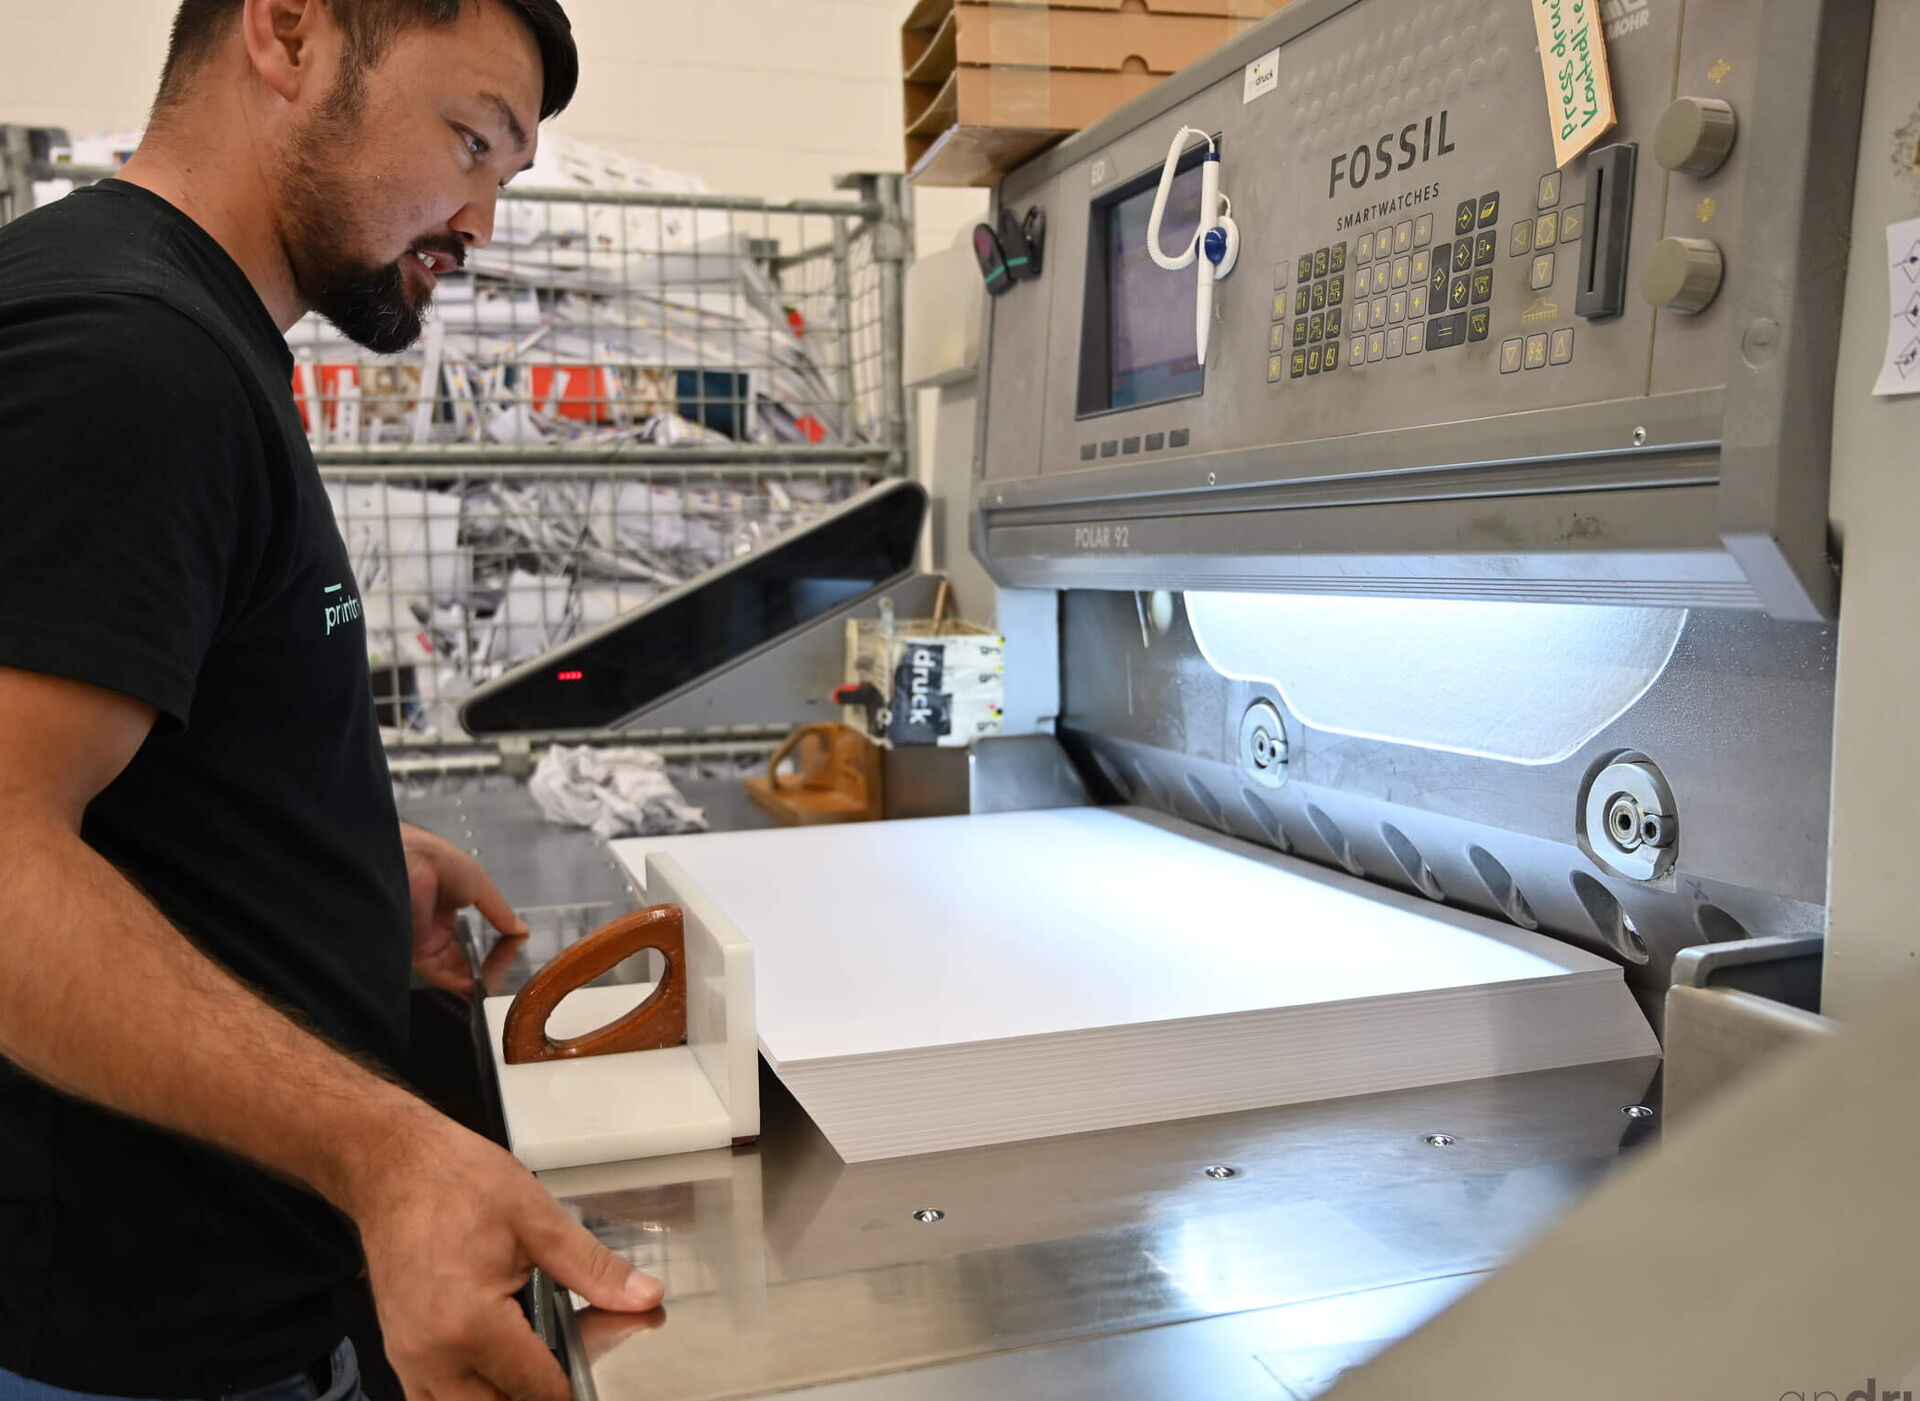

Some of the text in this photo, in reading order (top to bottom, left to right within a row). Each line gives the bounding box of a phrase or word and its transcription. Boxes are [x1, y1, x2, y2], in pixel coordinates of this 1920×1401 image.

[1542, 0, 1568, 57] druc
[1328, 110, 1455, 199] FOSSIL
[1336, 182, 1440, 232] SMARTWATCHES
[1075, 525, 1130, 549] POLAR 92
[909, 649, 936, 726] druck
